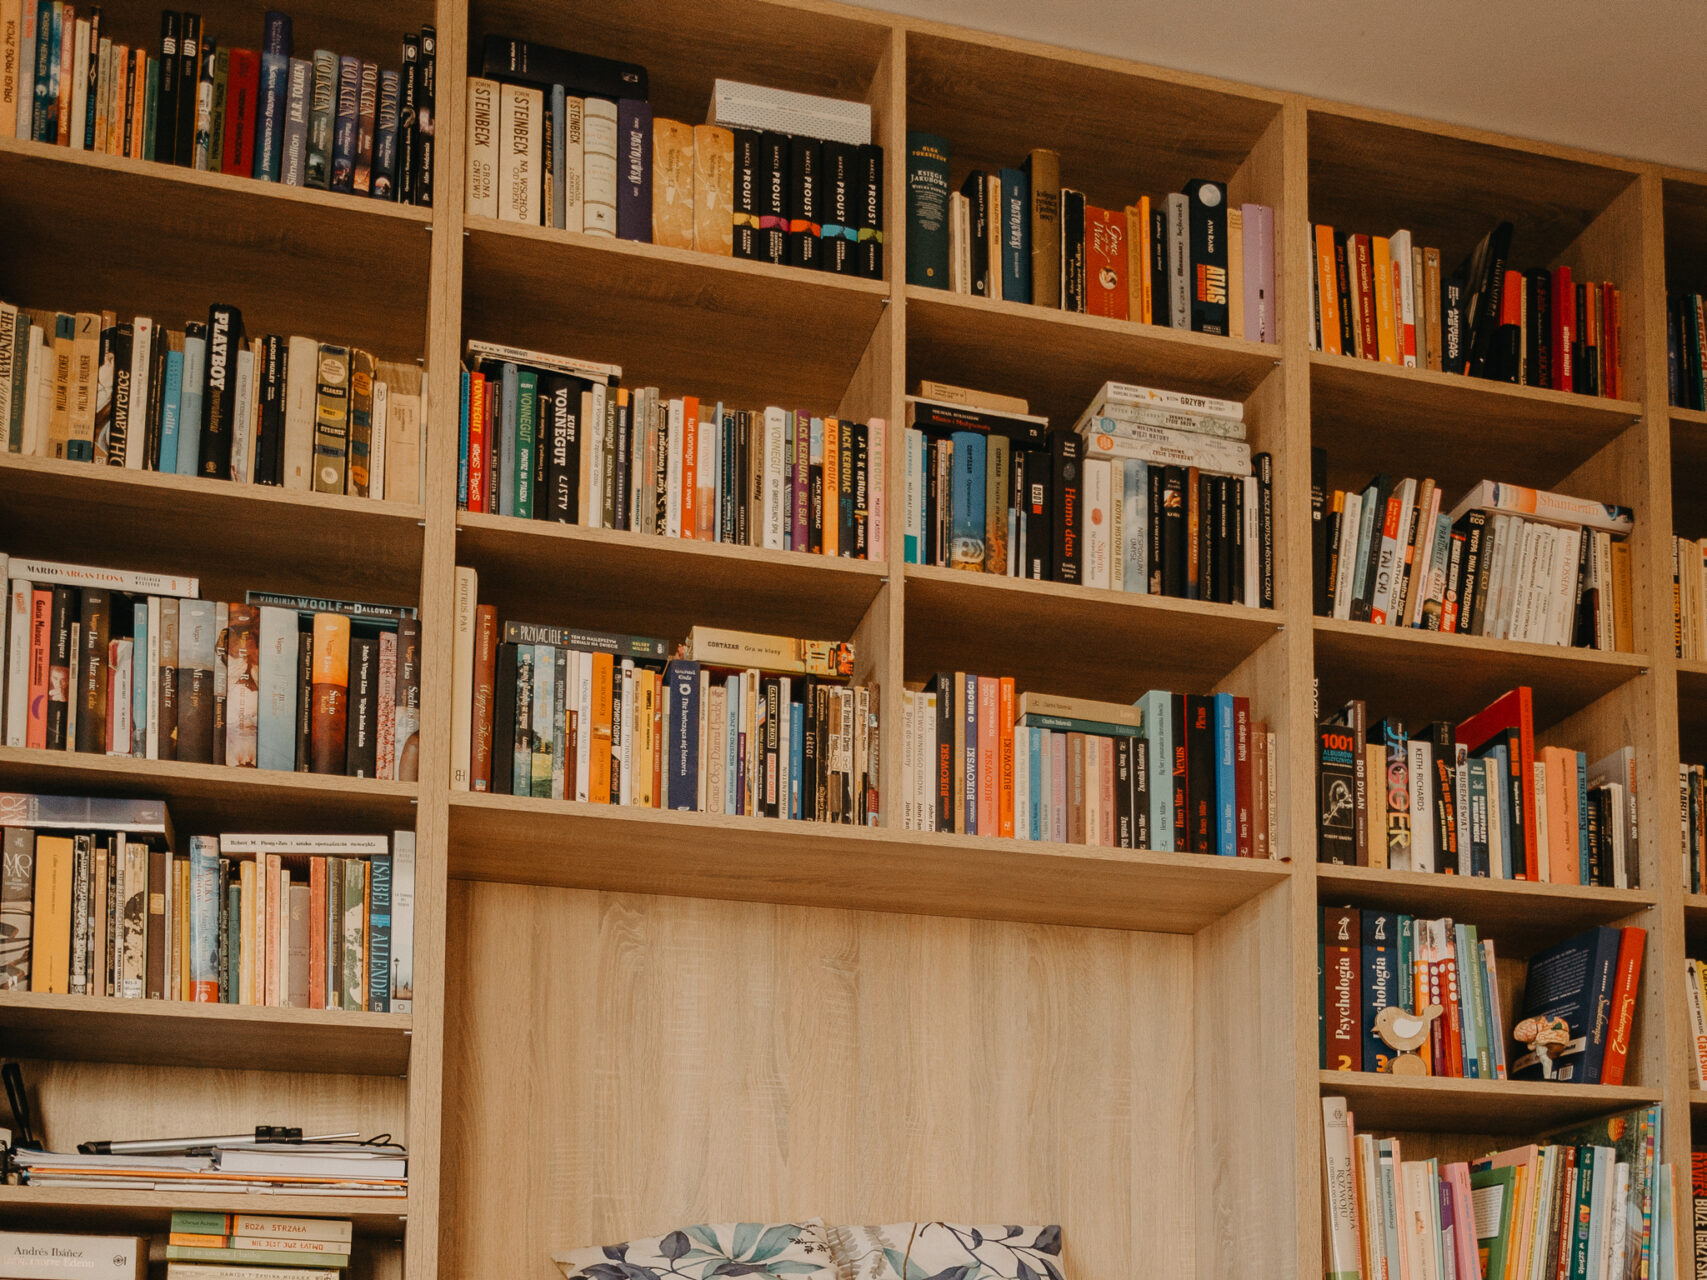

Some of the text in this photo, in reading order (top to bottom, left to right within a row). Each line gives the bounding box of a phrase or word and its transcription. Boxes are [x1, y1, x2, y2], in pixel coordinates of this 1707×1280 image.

[163, 38, 177, 54] LEM
[184, 39, 197, 56] LEM
[4, 76, 14, 103] DRUGI
[313, 55, 333, 112] TOLKIEN
[337, 61, 358, 118] TOLKIEN
[359, 63, 377, 115] TOLKIEN
[378, 73, 398, 130] TOLKIEN
[286, 135, 300, 186] Silmarillion
[293, 64, 306, 99] TOLKIEN
[474, 89, 491, 147] STEINBECK
[513, 97, 529, 156] STEINBECK
[569, 105, 582, 144] STEINBECK
[472, 160, 482, 200] GNIEWU
[481, 164, 491, 198] GRONA
[512, 168, 521, 210] OD EDENU
[518, 160, 529, 220] NA WSCHÓD
[743, 169, 751, 210] PROUST
[773, 172, 781, 213] PROUST
[804, 176, 812, 217] PROUST
[836, 181, 845, 222] PROUST
[868, 184, 876, 225] PROUST
[1206, 266, 1226, 304] ATLAS
[1, 312, 13, 380] HEMINGWAY
[211, 312, 229, 391] PLAYBOY
[165, 404, 176, 435] Lolita
[519, 393, 532, 442] VONNEGUT
[553, 389, 568, 466] VONNEGUT
[566, 415, 576, 441] KURT
[605, 416, 614, 449] vonnegut
[657, 432, 667, 493] Kurt Vonnegut
[685, 433, 694, 466] vonnegut
[771, 427, 780, 475] VONNEGUT
[828, 423, 837, 491] JACK KEROUAC
[842, 426, 851, 493] JACK KEROUAC
[798, 416, 808, 525] JACK KEROUAC BIG SUR
[558, 475, 568, 510] LISTY
[1064, 487, 1076, 557] Homo deus
[26, 565, 58, 576] MARIO
[1378, 550, 1391, 571] TAI
[1483, 535, 1493, 569] Umberto
[1461, 529, 1479, 628] WYSPA DNIA POPRZEDNIEGO
[298, 598, 343, 613] WOOLF
[460, 616, 469, 632] PAN
[806, 732, 814, 759] Lektor
[1173, 747, 1185, 776] Nexus
[1321, 734, 1353, 752] 1001
[941, 744, 949, 796] BUKOWSKI
[967, 747, 975, 800] BUKOWSKI
[1004, 738, 1012, 790] BUKOWSKI
[1356, 759, 1365, 809] BOB DYLAN
[1415, 748, 1425, 812] KEITH RICHARDS
[370, 861, 389, 997] ISABEL ALLENDE
[1335, 957, 1351, 1040] Psychologia
[1612, 1039, 1627, 1055] 2
[1578, 1205, 1590, 1240] ADHD
[14, 1247, 48, 1257] Andrés
